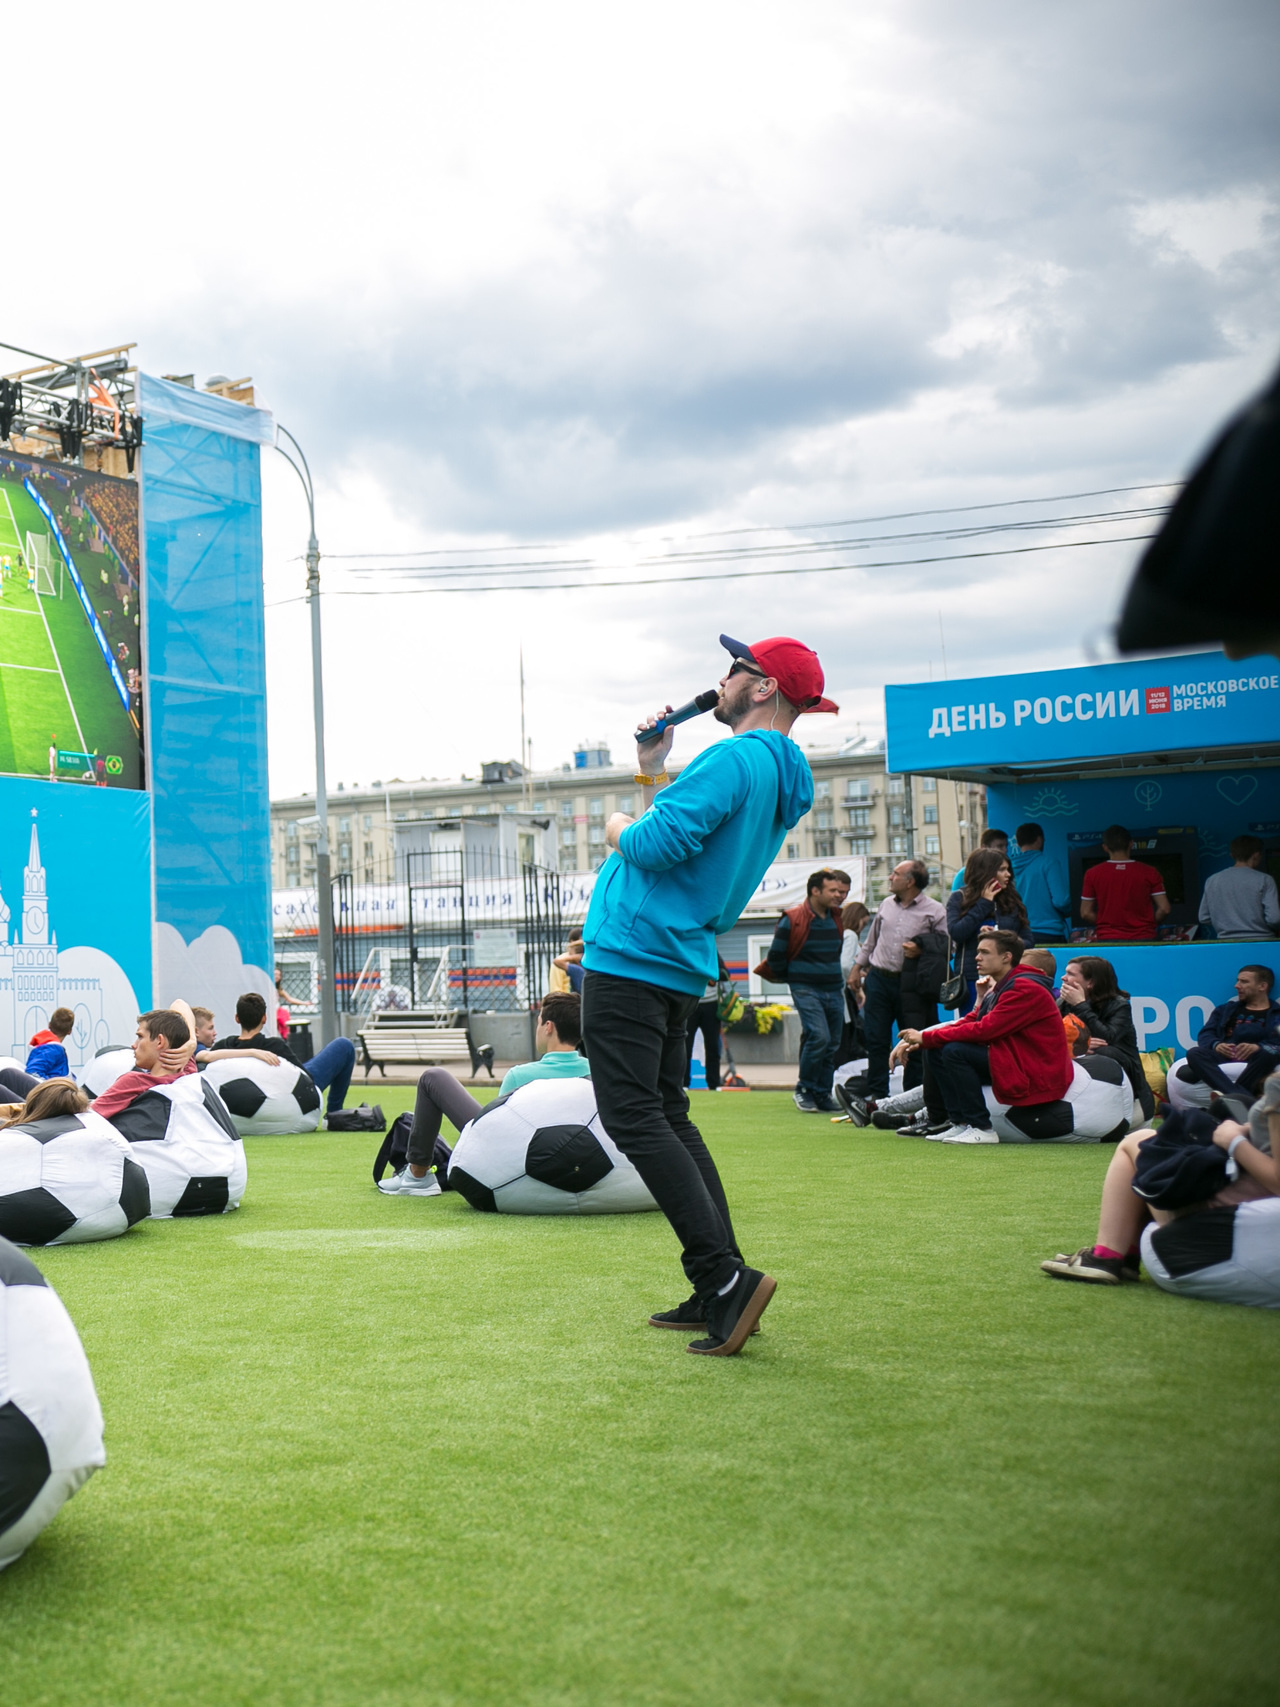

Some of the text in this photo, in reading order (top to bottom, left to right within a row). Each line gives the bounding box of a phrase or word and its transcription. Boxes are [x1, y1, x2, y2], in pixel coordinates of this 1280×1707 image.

[1173, 675, 1280, 697] МОСКОВСКОЕ
[928, 688, 1140, 739] ДЕНЬ РОССИИ
[1173, 695, 1227, 712] ВРЕМЯ
